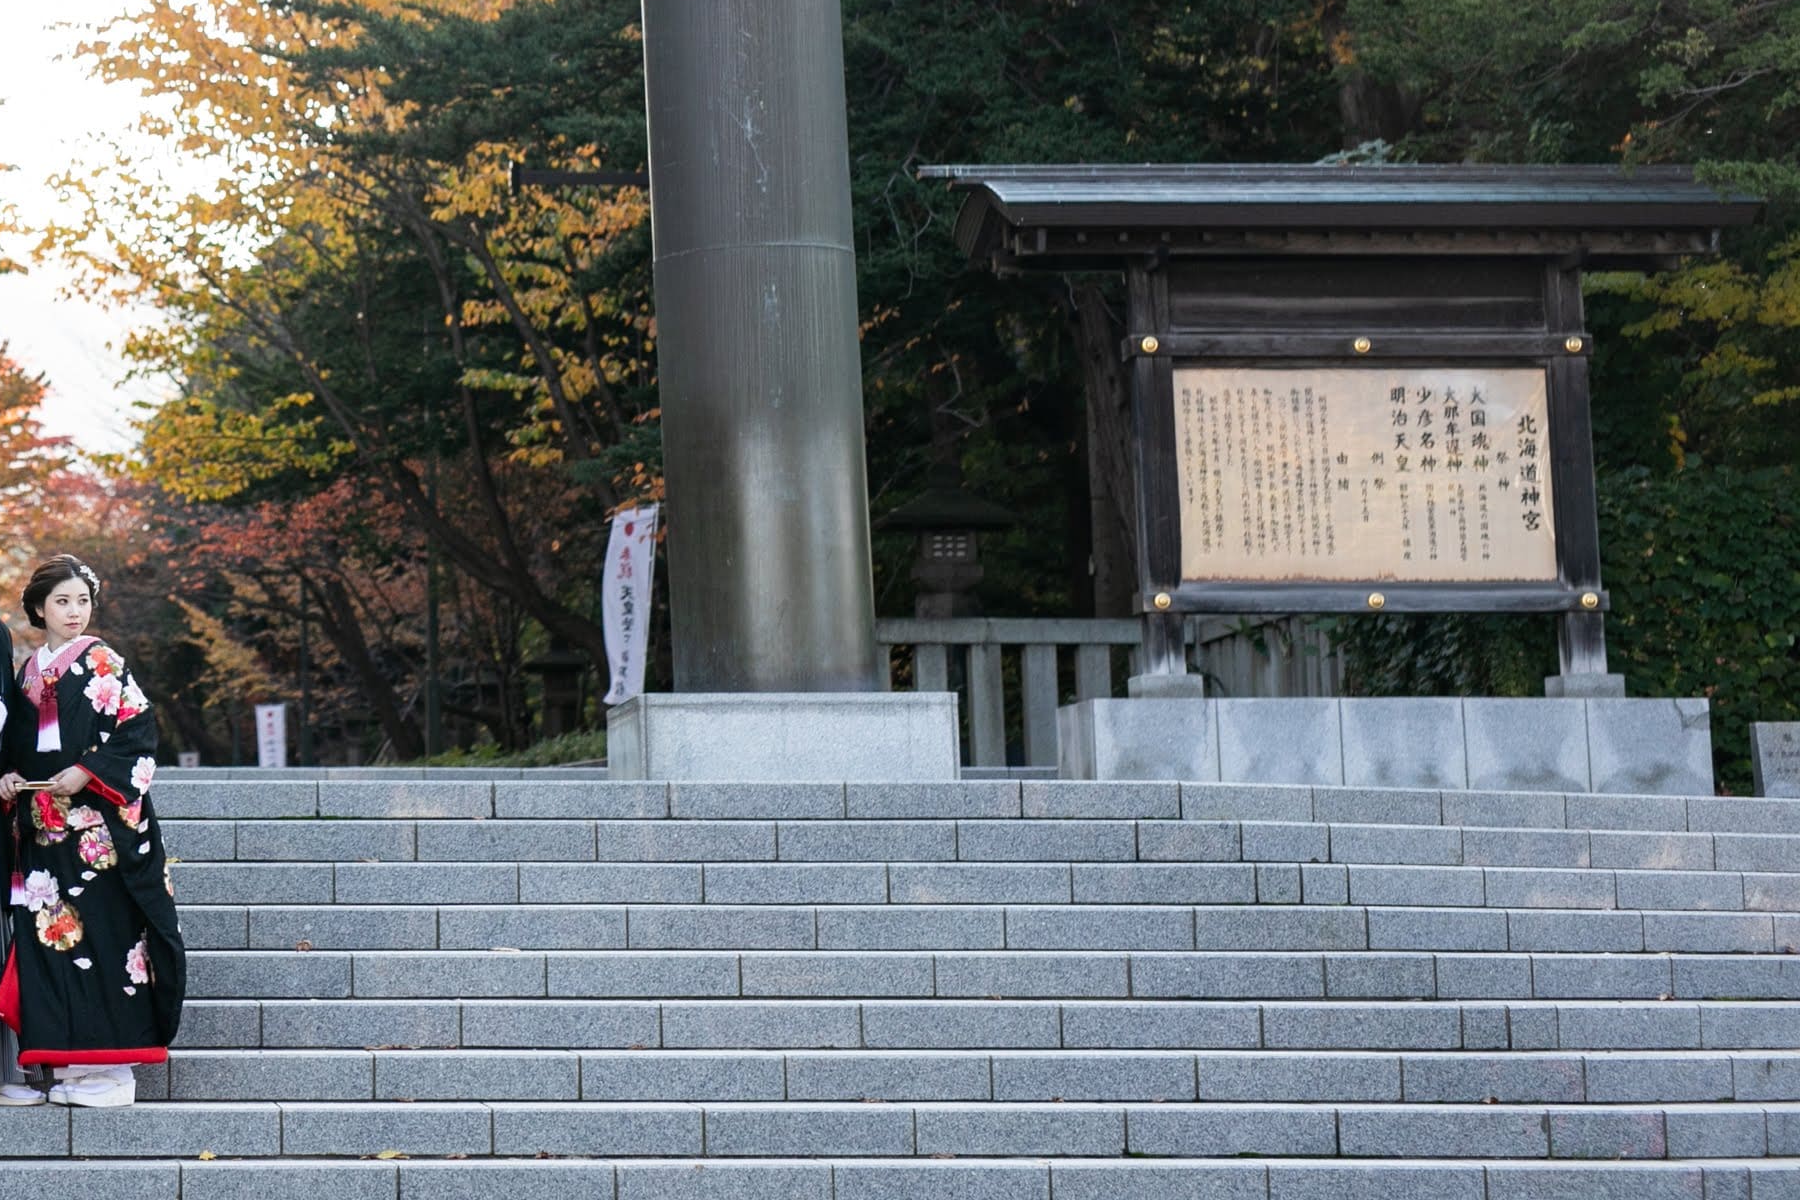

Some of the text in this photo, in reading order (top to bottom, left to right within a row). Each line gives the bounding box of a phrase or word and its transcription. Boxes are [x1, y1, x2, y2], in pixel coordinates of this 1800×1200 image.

[1390, 385, 1410, 474] 明治天皇
[1416, 385, 1437, 473] 少彦名神
[1469, 385, 1491, 473] 大国魂神
[1517, 414, 1541, 532] 北海道神宮
